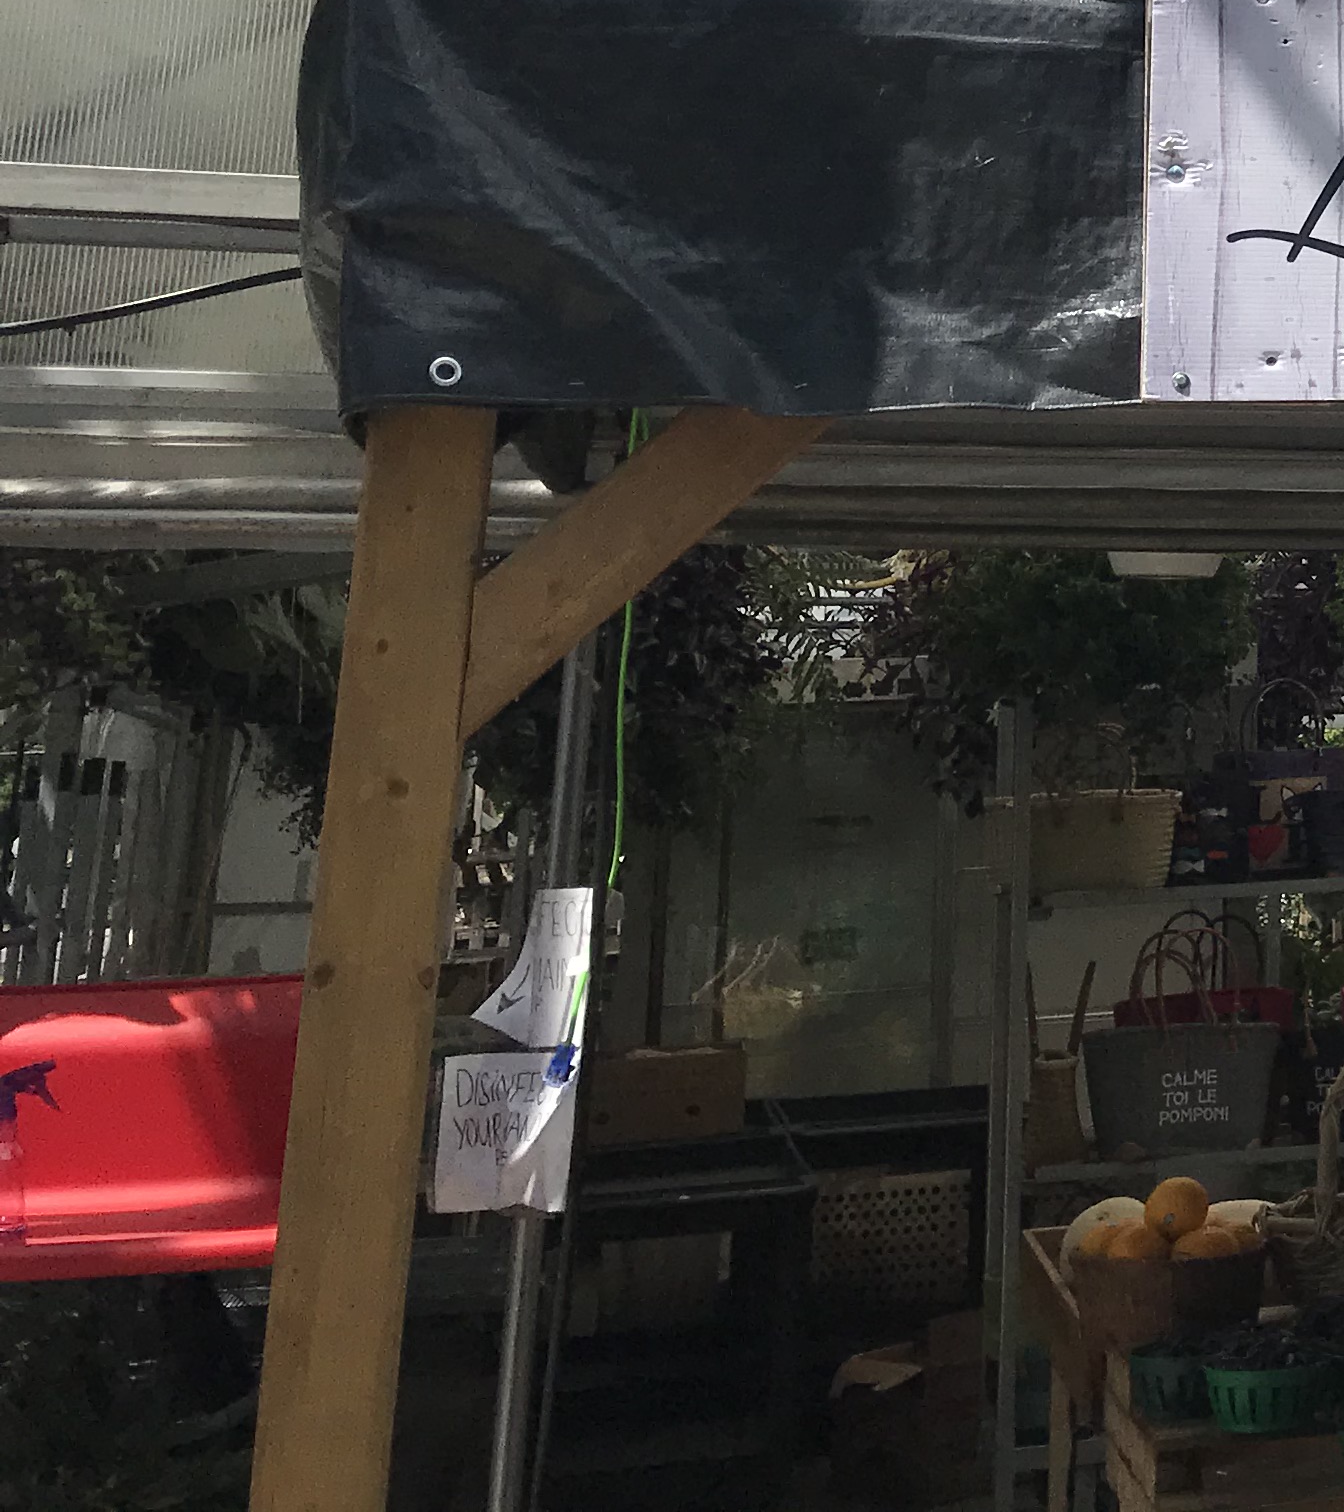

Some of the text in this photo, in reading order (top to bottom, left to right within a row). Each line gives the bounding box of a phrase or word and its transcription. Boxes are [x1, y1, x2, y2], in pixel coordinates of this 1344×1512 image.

[1161, 1068, 1218, 1088] CALME
[1162, 1088, 1217, 1107] TOI LE
